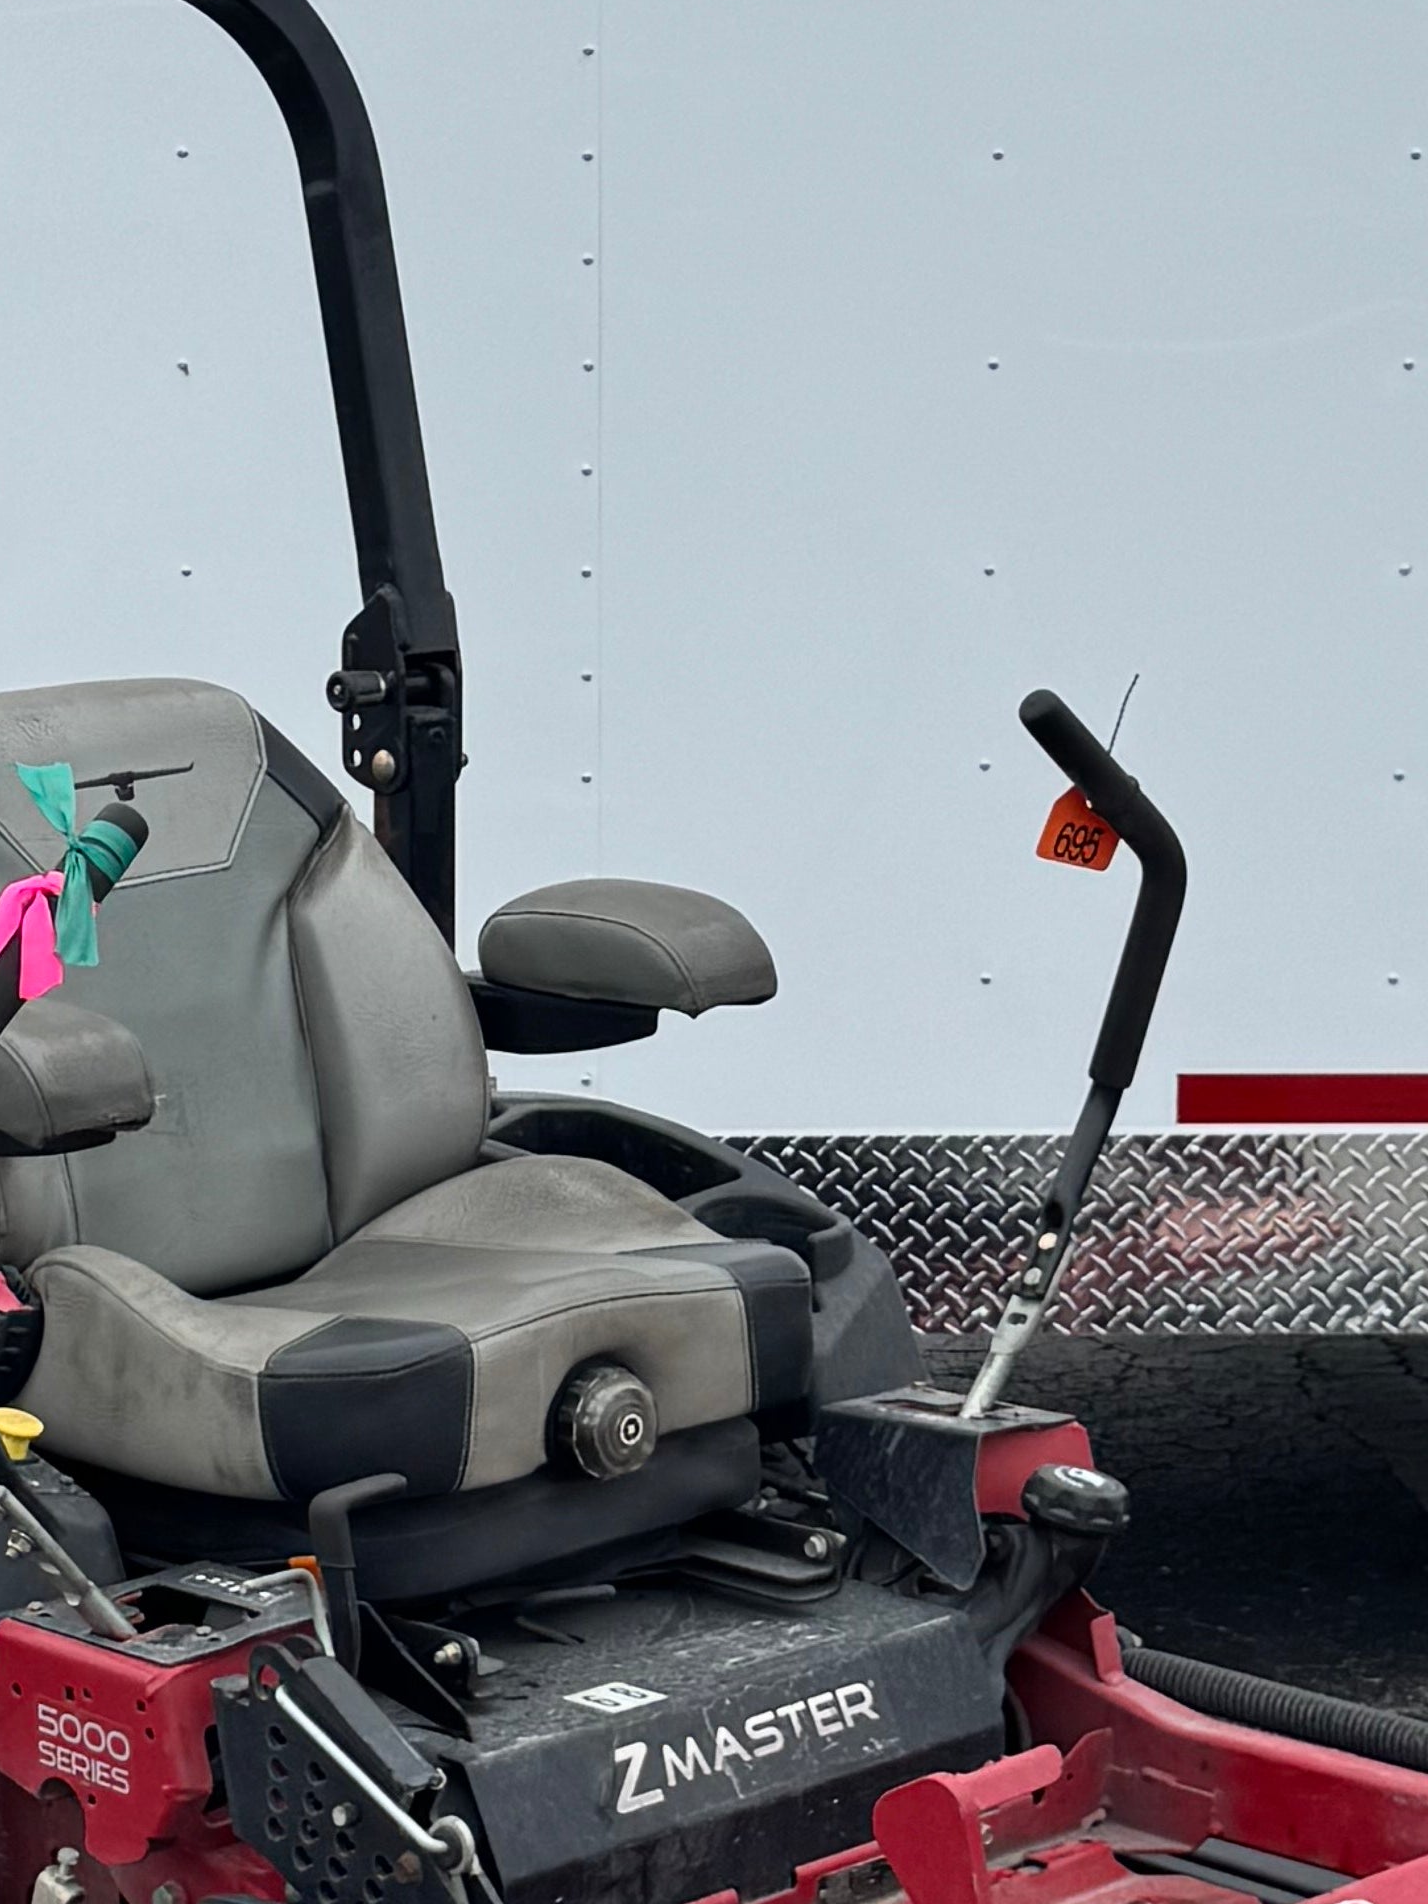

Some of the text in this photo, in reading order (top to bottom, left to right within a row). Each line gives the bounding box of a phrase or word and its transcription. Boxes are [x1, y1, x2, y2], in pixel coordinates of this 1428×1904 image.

[1054, 822, 1104, 864] 695
[37, 1703, 131, 1762] 5000
[37, 1740, 130, 1795] SERIES
